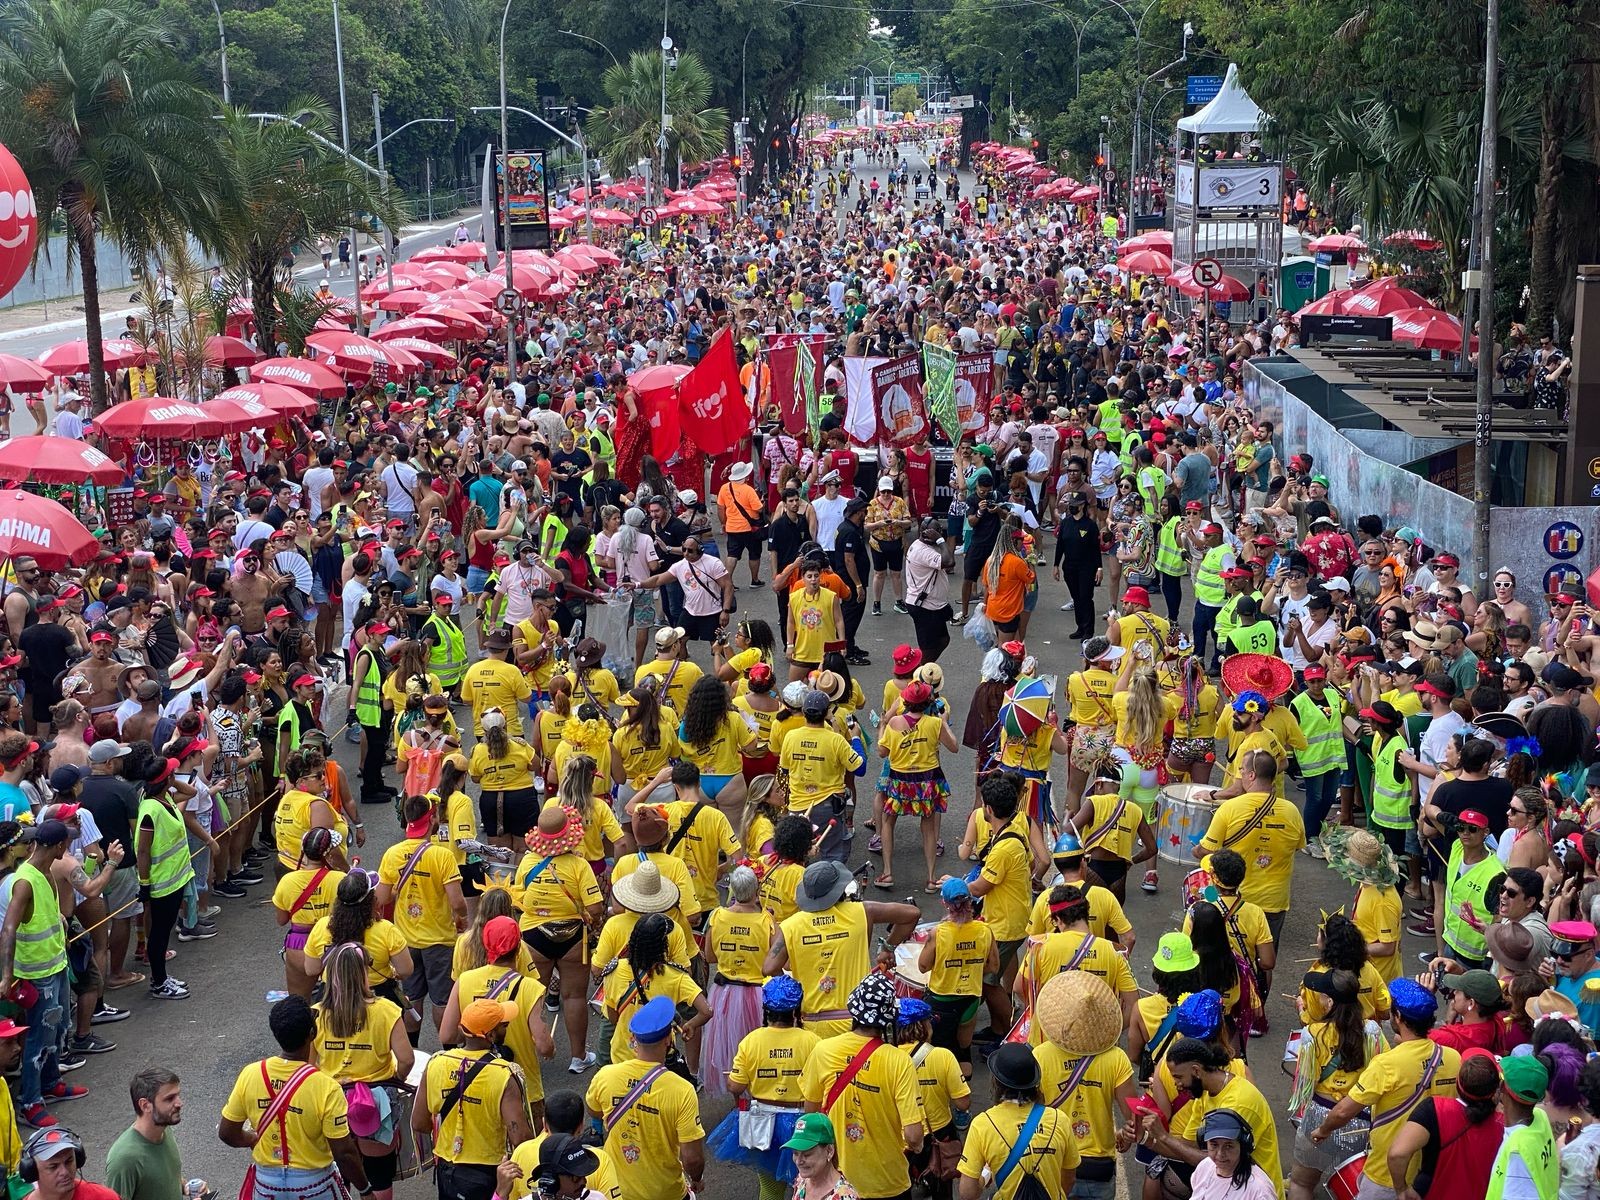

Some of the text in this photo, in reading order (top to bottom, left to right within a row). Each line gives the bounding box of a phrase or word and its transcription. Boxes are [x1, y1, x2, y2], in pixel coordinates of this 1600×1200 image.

[1259, 178, 1270, 195] 3
[1202, 264, 1213, 281] E
[389, 339, 431, 351] BRAHMA
[344, 345, 387, 362] BRAHMA
[263, 365, 312, 385] BRAHMA
[898, 365, 919, 379] ABERTAS
[968, 364, 991, 375] ABERTAS
[149, 403, 209, 421] BRAHMA
[1251, 633, 1268, 649] 53
[1467, 880, 1481, 893] 312
[812, 915, 836, 926] BATERIA
[730, 926, 750, 936] BATERIA
[956, 941, 976, 951] BATERIA
[769, 1048, 793, 1059] BATERIA
